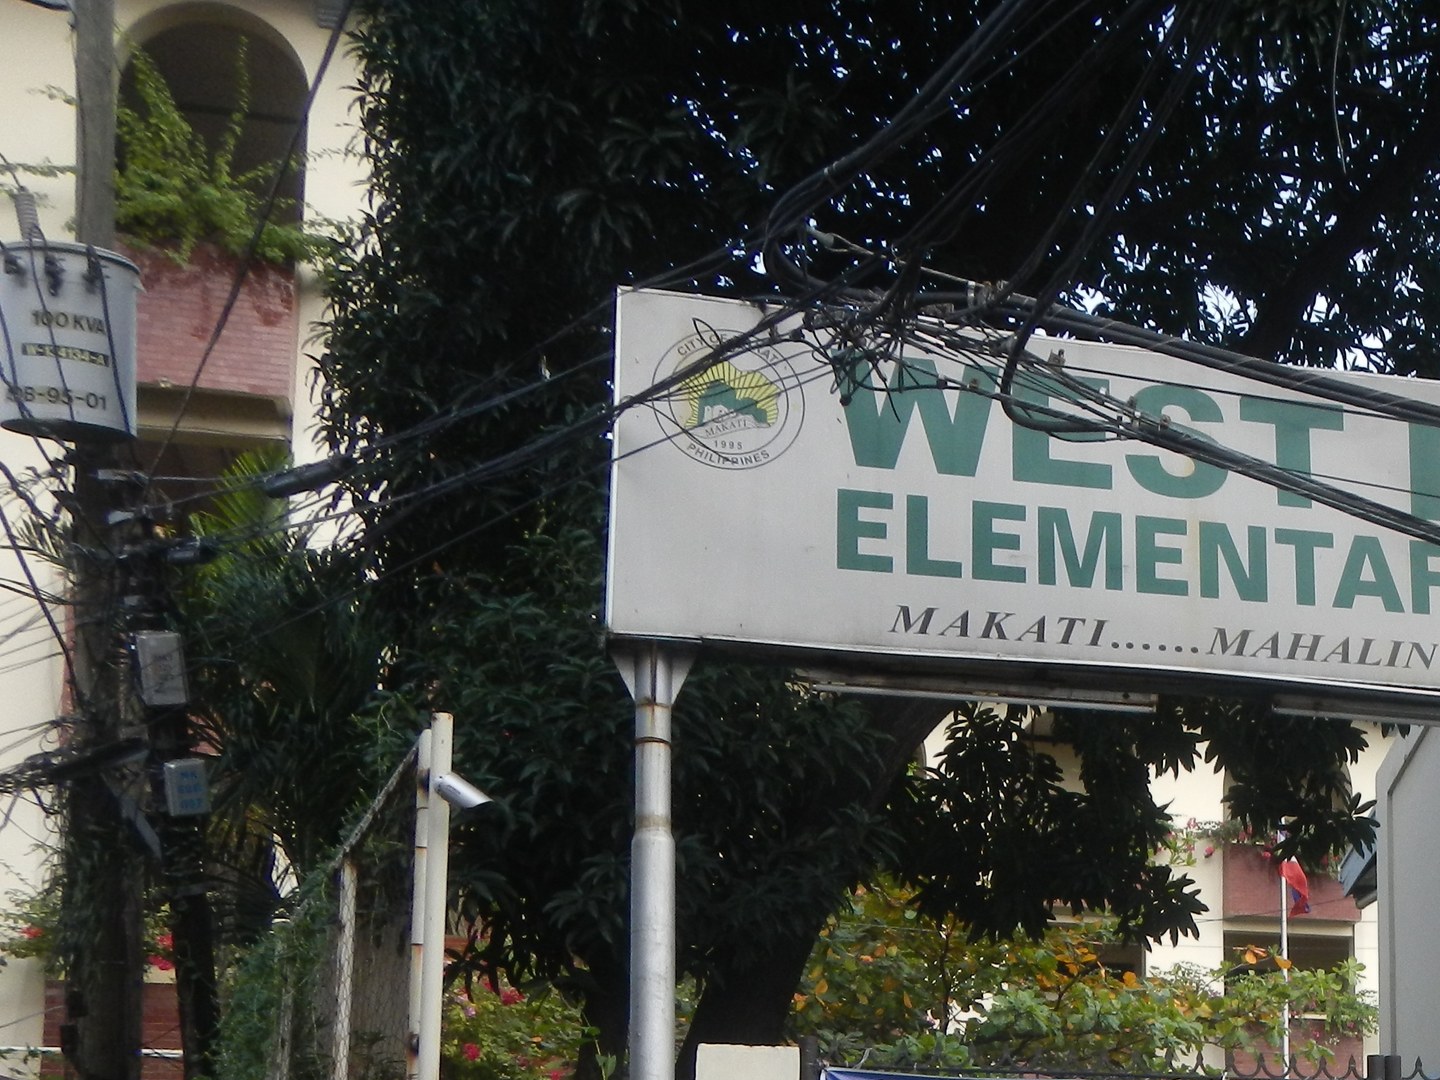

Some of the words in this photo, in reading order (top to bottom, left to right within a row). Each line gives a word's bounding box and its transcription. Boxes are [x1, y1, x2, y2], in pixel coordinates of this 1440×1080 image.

[32, 311, 69, 328] 100
[73, 314, 106, 335] KVA
[677, 337, 705, 356] CITY
[703, 419, 748, 437] MAKATI
[833, 349, 1344, 508] WEST
[686, 443, 770, 466] PHILIPPINES
[713, 439, 743, 449] 1995
